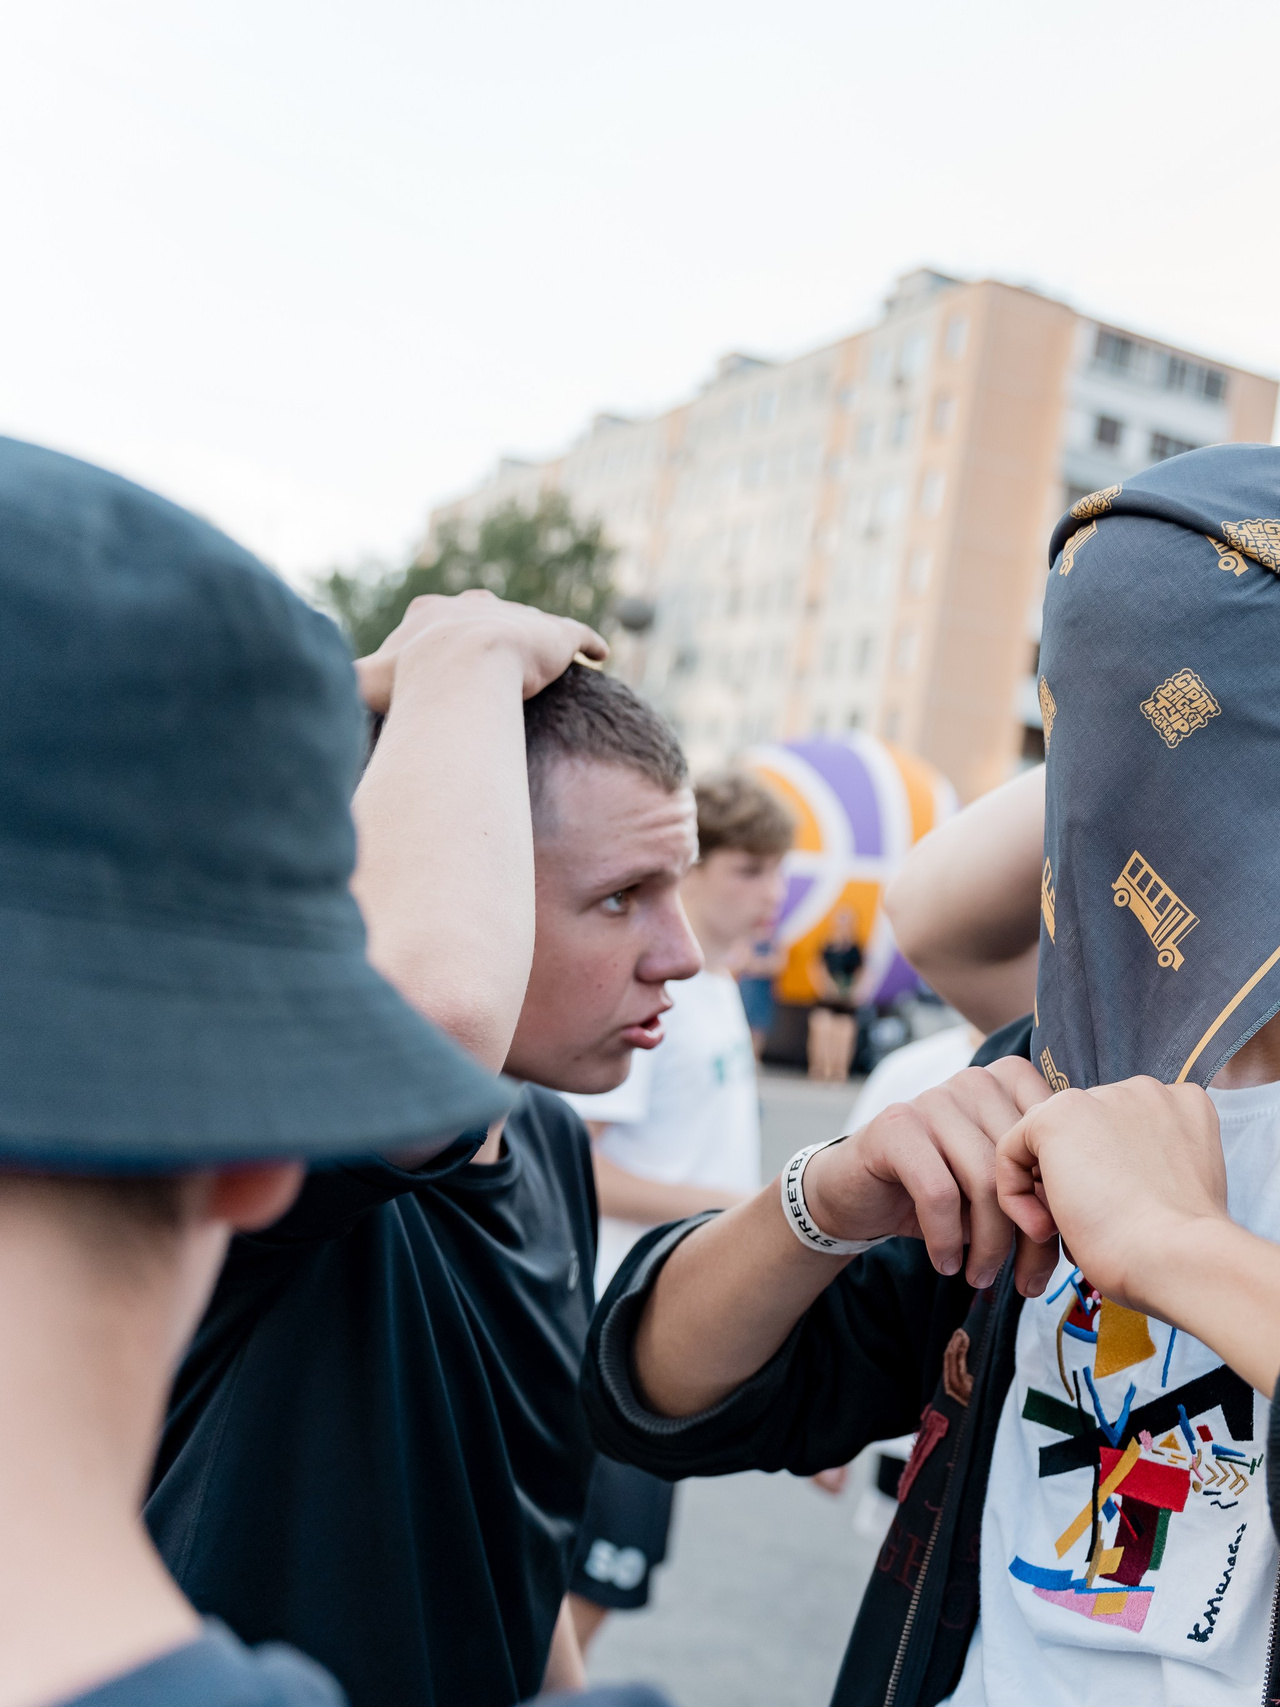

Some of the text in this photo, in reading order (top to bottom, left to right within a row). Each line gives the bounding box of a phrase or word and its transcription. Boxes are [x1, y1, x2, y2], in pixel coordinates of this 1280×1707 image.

[1155, 693, 1190, 733] ТУР
[1158, 682, 1205, 728] БАСКЕТ
[1173, 673, 1217, 717] СТРИТ
[1144, 700, 1178, 744] МОСКВА
